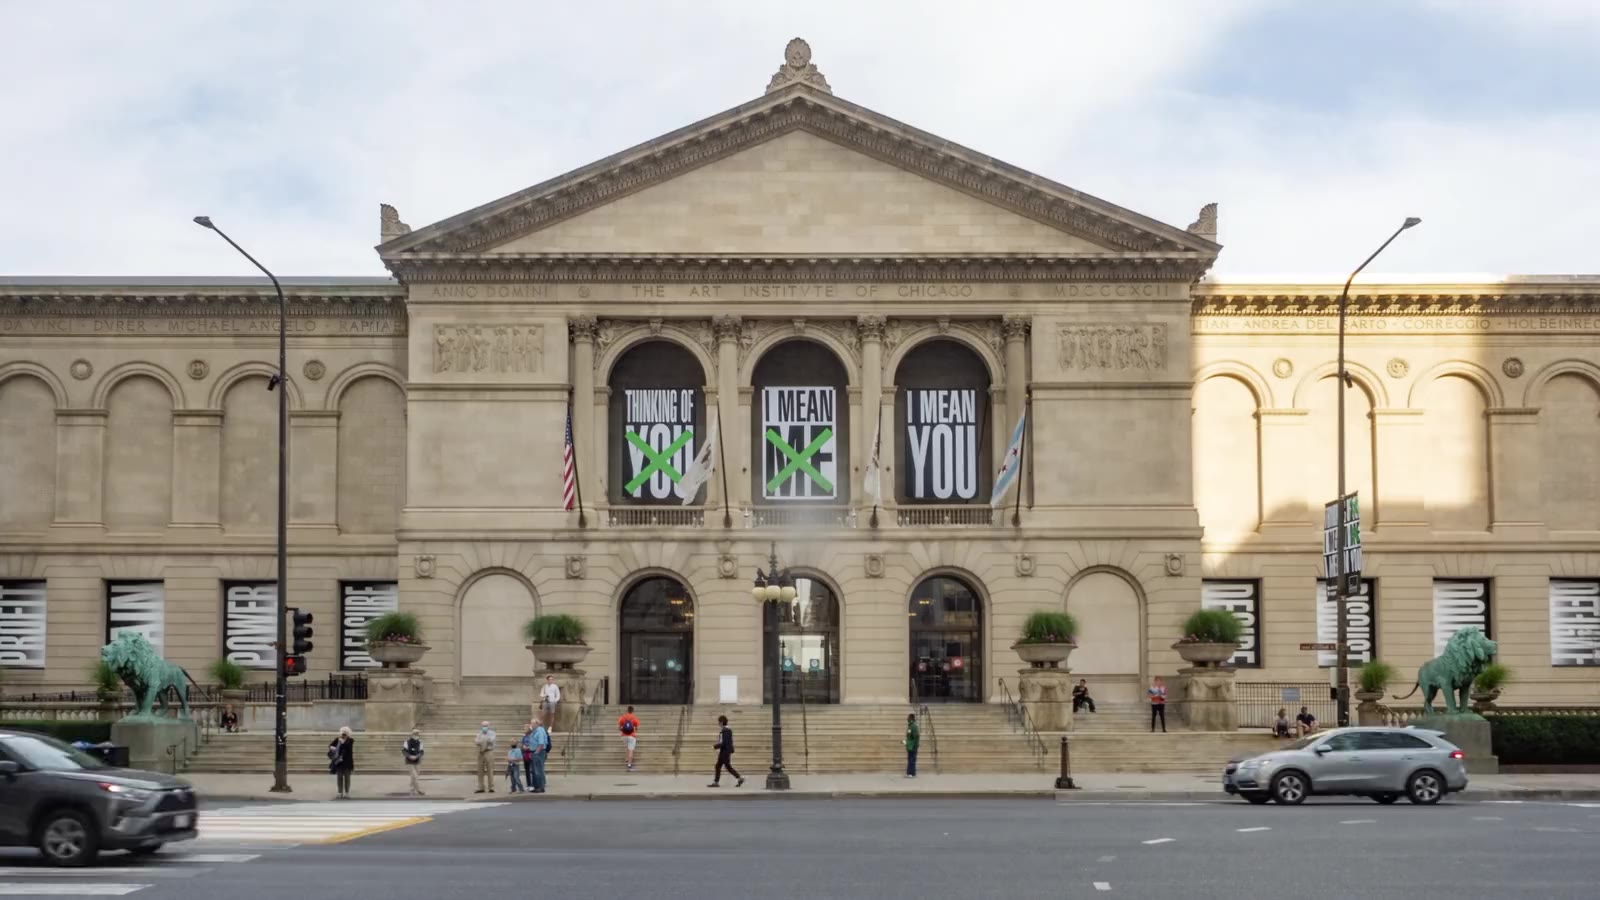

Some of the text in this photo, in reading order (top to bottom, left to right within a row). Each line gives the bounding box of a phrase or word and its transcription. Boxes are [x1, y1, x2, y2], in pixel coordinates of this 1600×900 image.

[432, 285, 1170, 298] ANNO DOMINI THE ART INSTITVTE OF CHICAGO MDCCCXCII
[1242, 318, 1301, 330] ANDREA
[1306, 318, 1335, 330] DEL
[1343, 318, 1387, 330] SARTO
[1403, 318, 1491, 330] CORREGGIO
[31, 319, 72, 332] VINCI
[168, 319, 240, 332] MICHAEL
[625, 389, 694, 423] THINKING OF
[765, 389, 833, 422] I MEAN
[907, 390, 976, 423] I MEAN
[624, 423, 694, 499] YOU
[765, 425, 833, 497] ME
[907, 424, 978, 499] YOU
[0, 585, 46, 666] PROFIT
[110, 584, 163, 650] AIN
[226, 585, 277, 666] POWER
[1202, 583, 1256, 664] DEE
[1435, 583, 1486, 648] DOU
